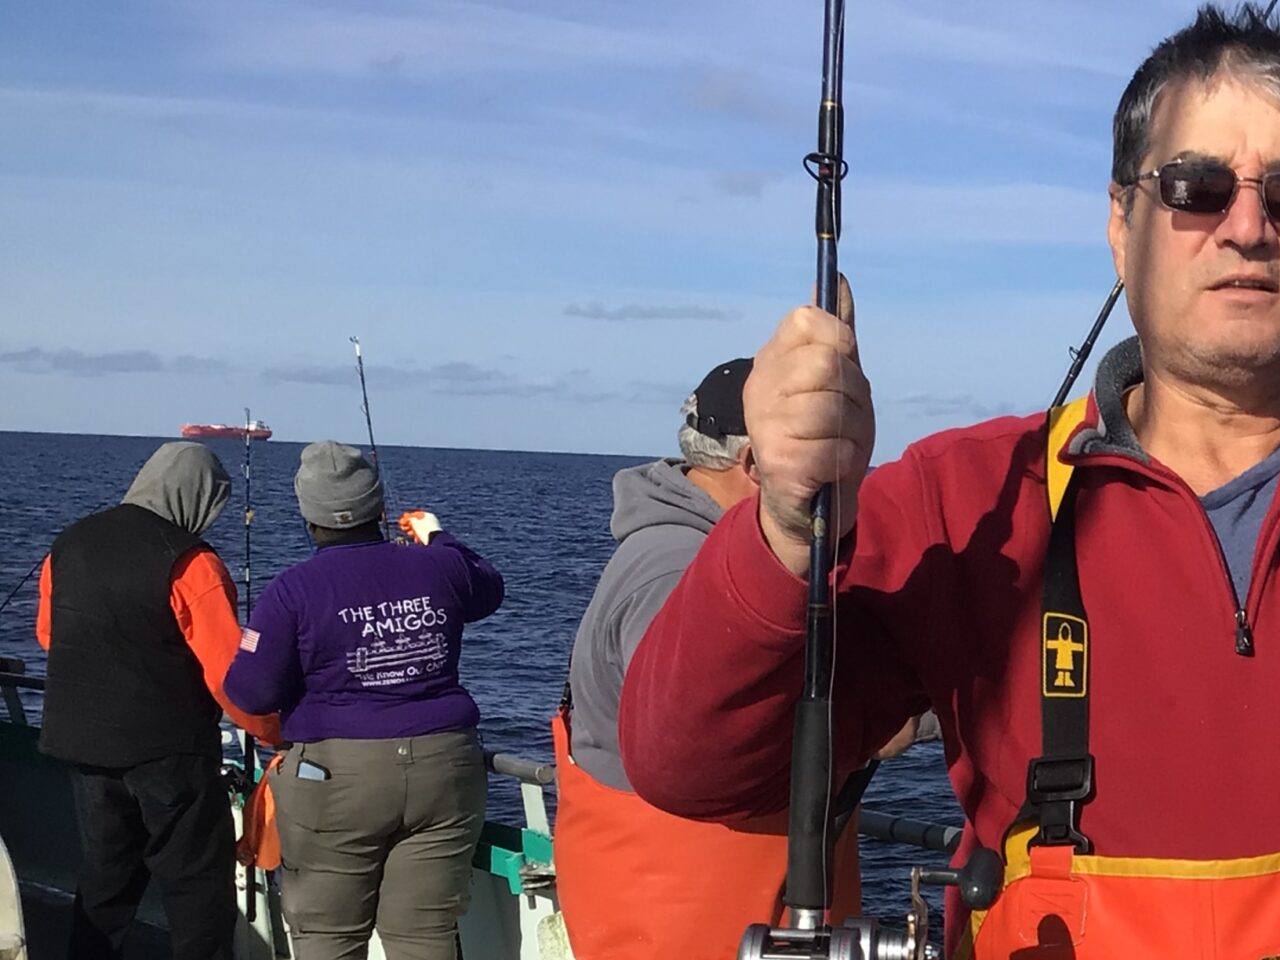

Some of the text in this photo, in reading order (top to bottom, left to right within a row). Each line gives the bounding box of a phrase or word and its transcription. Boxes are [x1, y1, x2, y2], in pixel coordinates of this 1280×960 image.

[338, 596, 431, 624] THE THREE
[362, 608, 447, 638] AMIGOS
